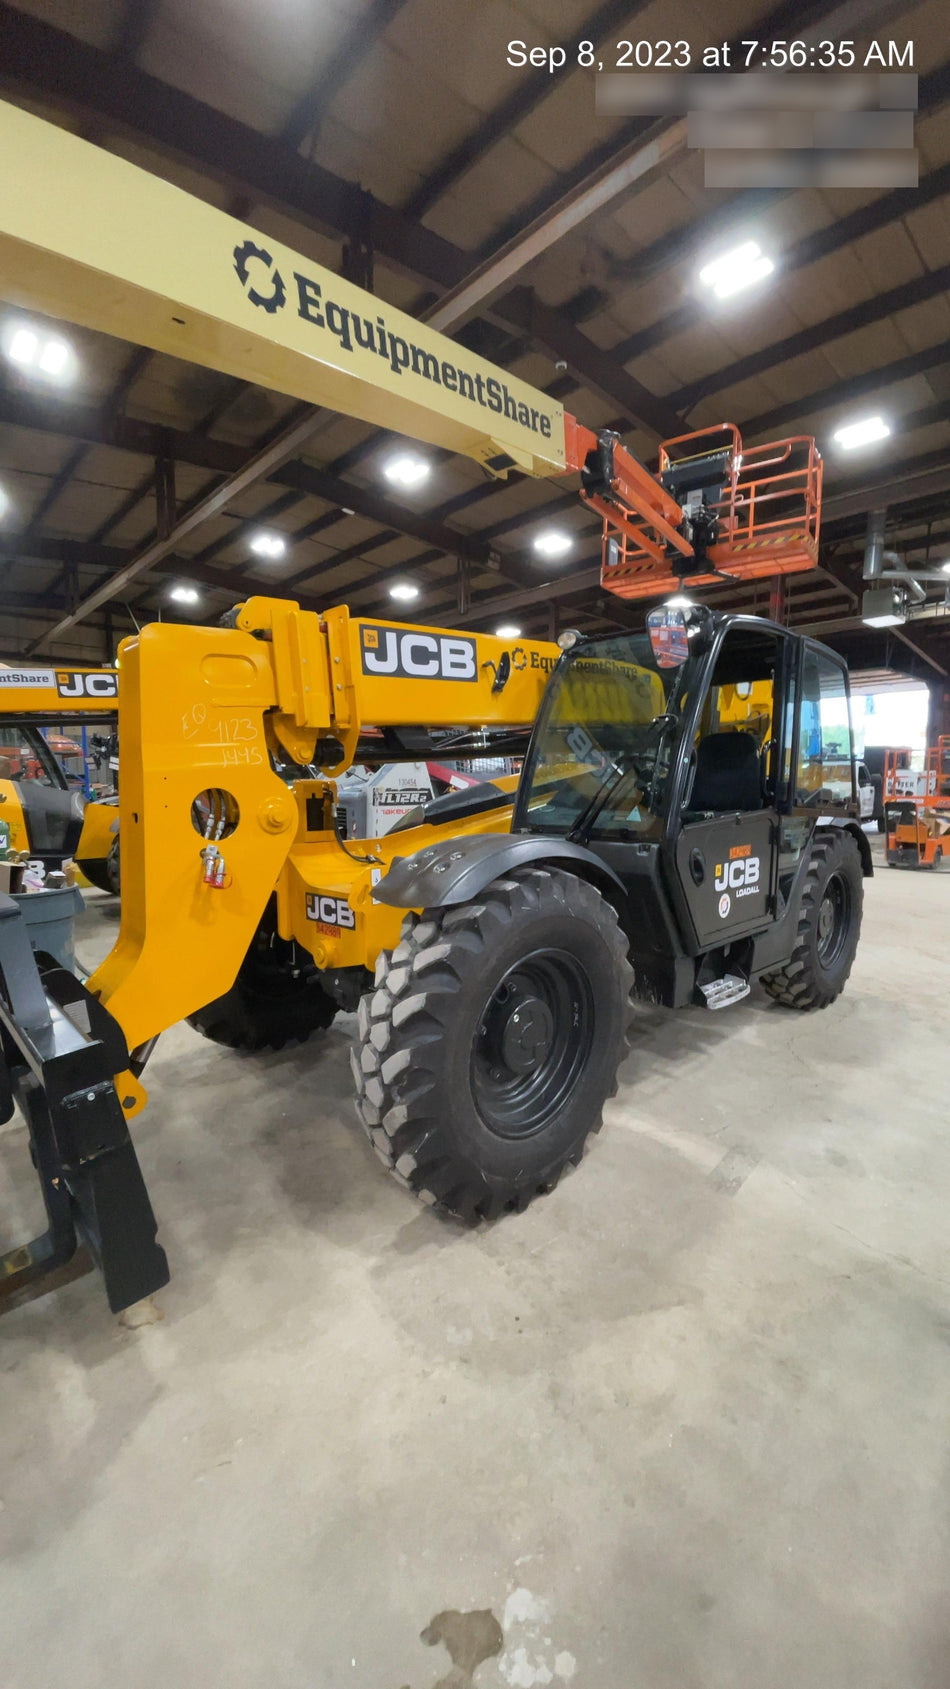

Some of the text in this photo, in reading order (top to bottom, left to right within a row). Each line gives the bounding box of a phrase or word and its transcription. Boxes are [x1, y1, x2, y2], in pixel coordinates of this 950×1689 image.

[294, 271, 552, 438] EquipmentShare
[365, 632, 476, 679] JCB
[60, 674, 118, 696] JC
[715, 857, 760, 892] JCB
[736, 885, 760, 898] LOADALL
[307, 896, 355, 928] JCB
